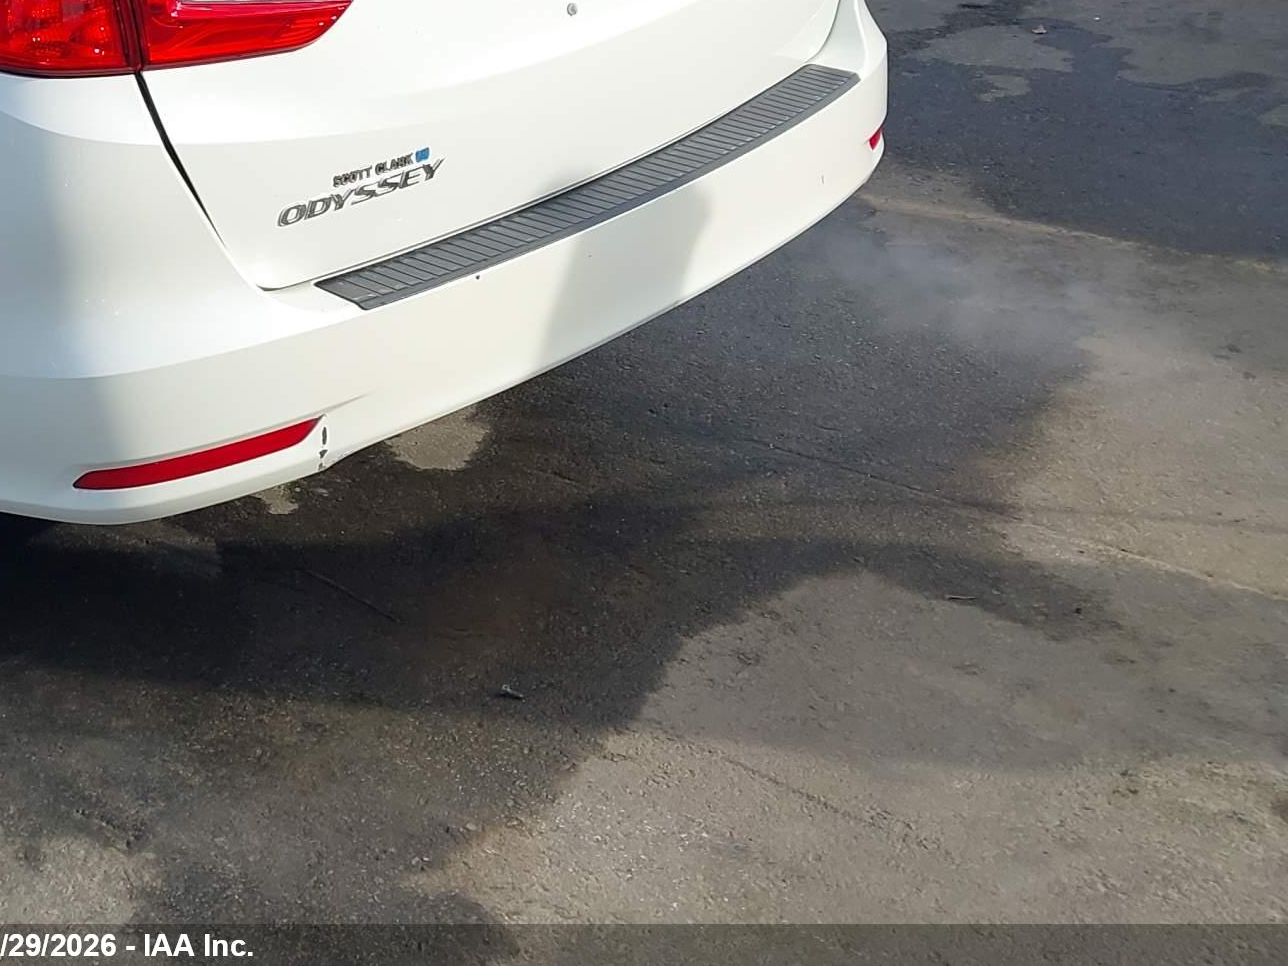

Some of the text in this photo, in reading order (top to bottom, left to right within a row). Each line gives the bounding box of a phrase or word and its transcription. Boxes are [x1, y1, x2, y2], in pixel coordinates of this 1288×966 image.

[277, 157, 447, 227] ODYSSEY
[332, 166, 372, 187] SCOTT
[374, 153, 414, 176] CLARK
